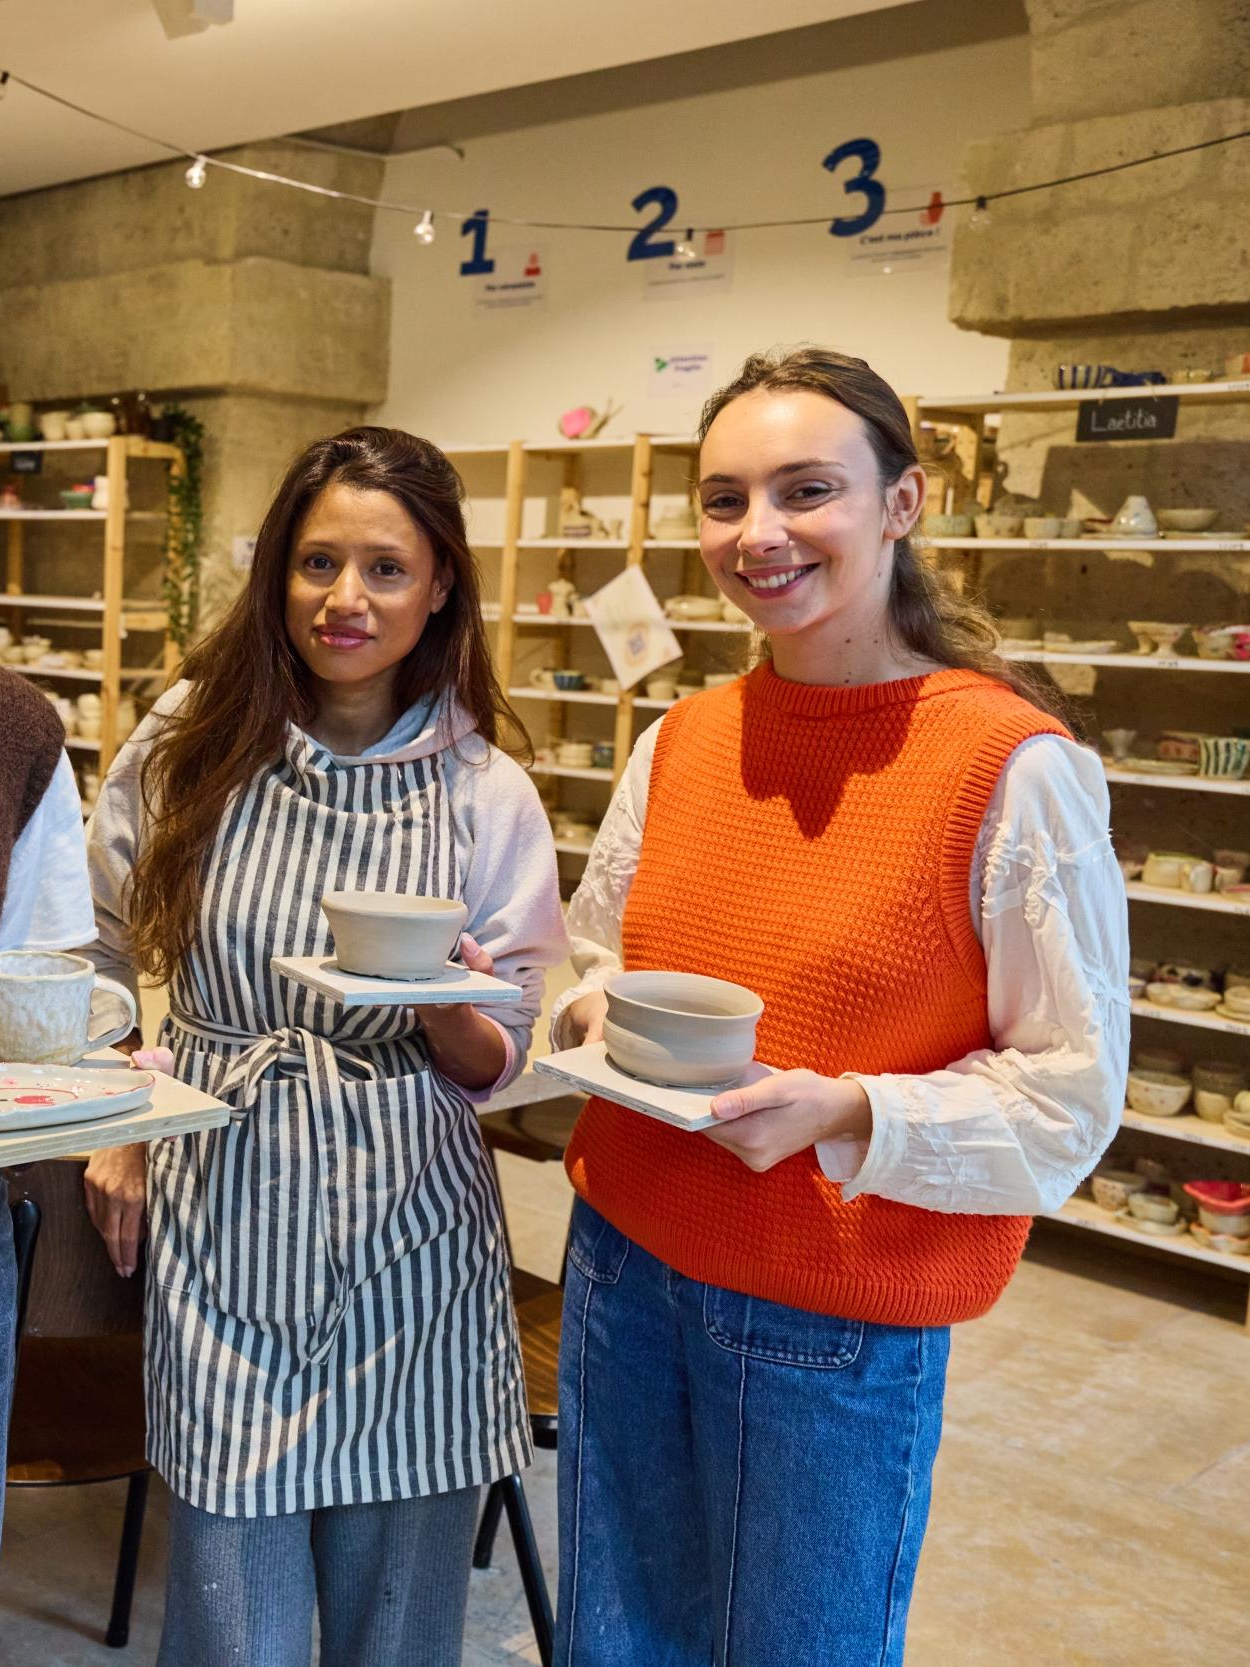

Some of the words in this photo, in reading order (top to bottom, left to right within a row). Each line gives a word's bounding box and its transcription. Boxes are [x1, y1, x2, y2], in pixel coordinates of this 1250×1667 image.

[626, 185, 678, 261] 2
[822, 138, 886, 237] 3
[460, 209, 495, 276] 1
[1090, 406, 1158, 432] Laetitia
